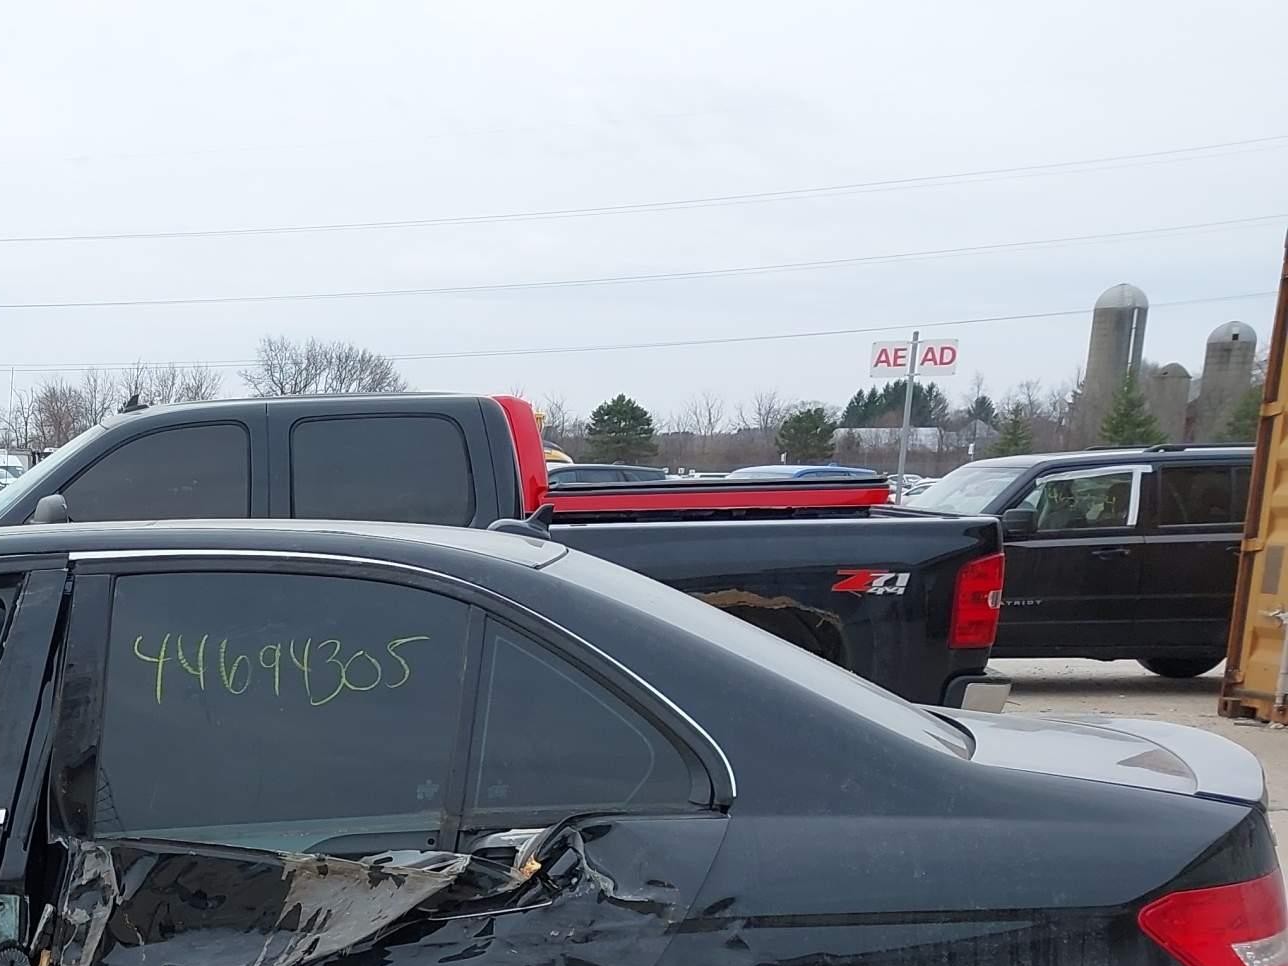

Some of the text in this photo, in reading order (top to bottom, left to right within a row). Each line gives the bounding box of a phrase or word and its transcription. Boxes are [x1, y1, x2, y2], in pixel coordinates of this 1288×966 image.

[873, 347, 907, 367] AE
[919, 346, 957, 366] AD
[831, 569, 911, 592] Z71
[133, 633, 431, 706] 44694305
